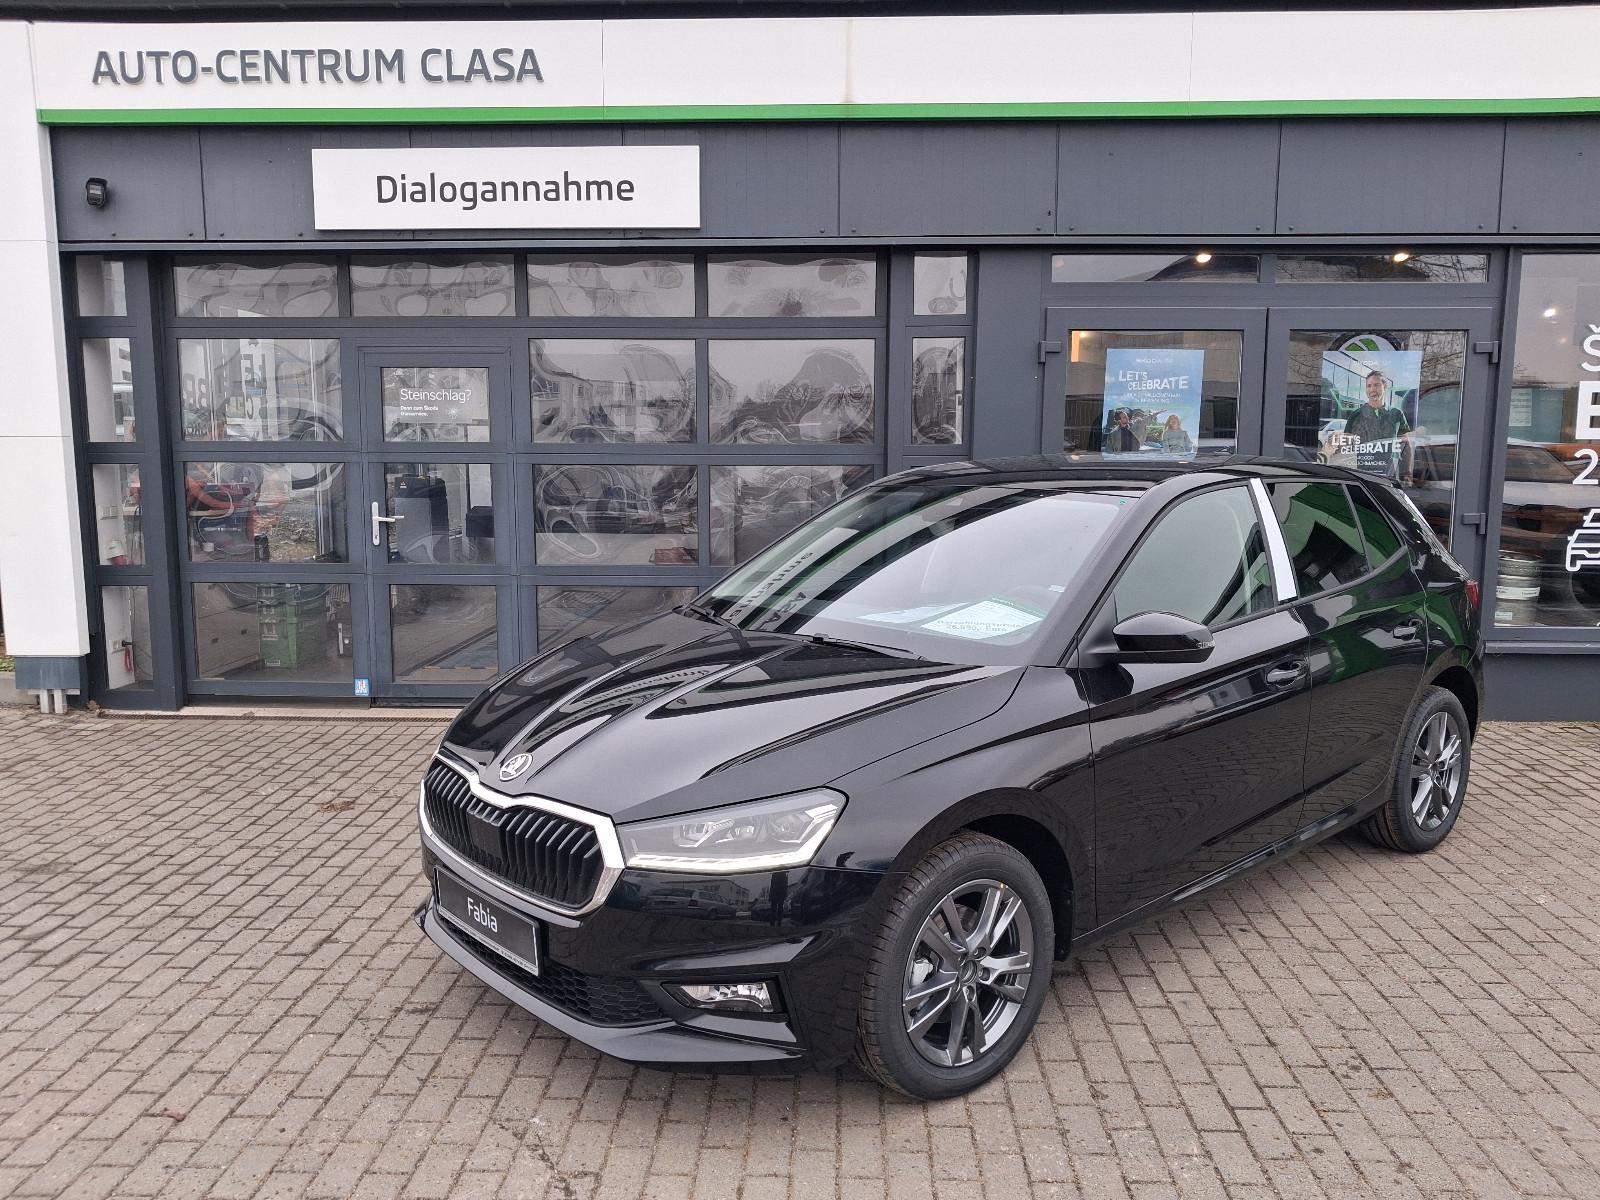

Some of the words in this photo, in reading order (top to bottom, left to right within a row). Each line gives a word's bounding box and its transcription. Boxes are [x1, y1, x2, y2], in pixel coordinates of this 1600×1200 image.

[92, 48, 405, 85] AUTO-CENTRUM
[420, 47, 544, 83] CLASA
[376, 172, 635, 211] Dialogannahme
[1118, 370, 1148, 382] LET'S
[1127, 376, 1189, 391] CELEBRATE
[400, 388, 472, 404] Steinschlag?
[1331, 434, 1361, 446] LET'S
[1340, 438, 1402, 455] CELEBRATE
[467, 896, 498, 933] Fabia
